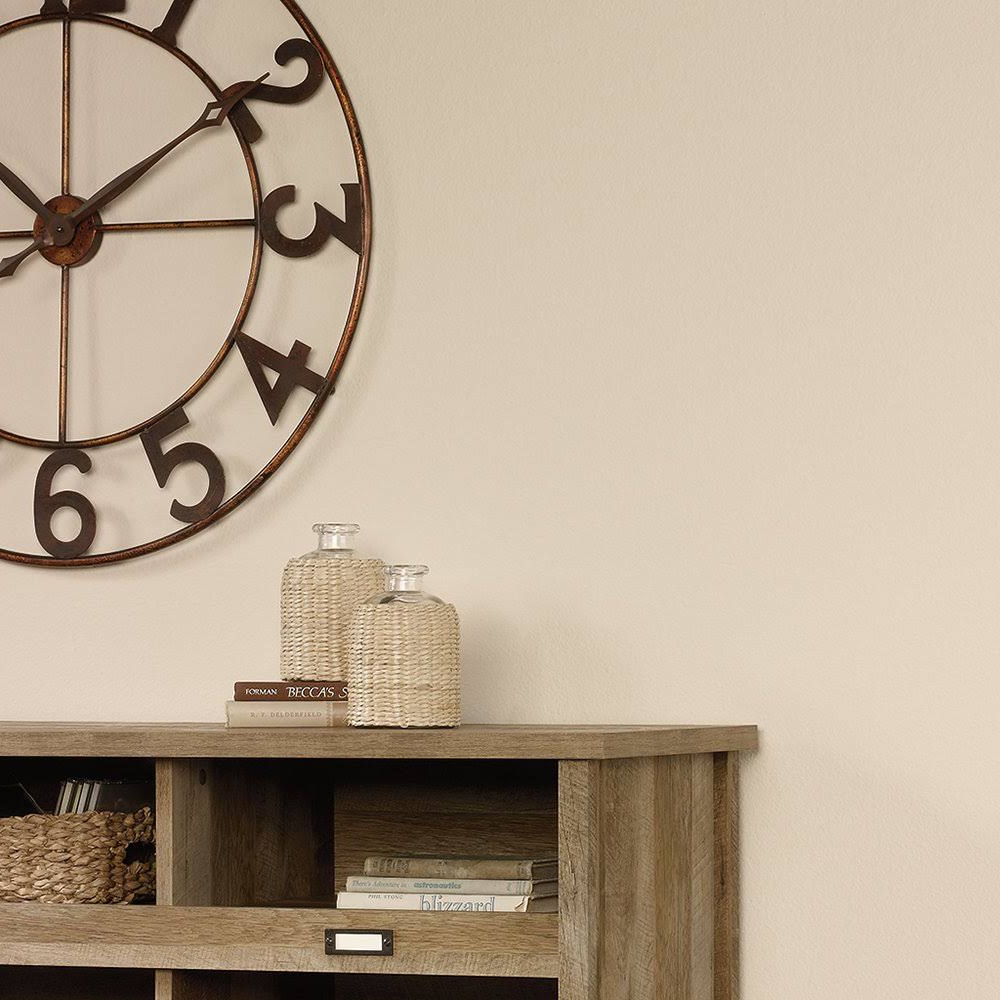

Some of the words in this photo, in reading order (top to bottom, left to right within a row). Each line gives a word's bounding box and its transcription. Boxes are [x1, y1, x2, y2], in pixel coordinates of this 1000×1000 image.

[220, 38, 325, 144] 2
[260, 183, 362, 258] 3
[234, 330, 333, 426] 4
[33, 448, 97, 559] 6
[139, 406, 226, 523] 5
[286, 686, 335, 698] BECCA'S
[414, 881, 462, 890] astronautics
[420, 894, 495, 912] blizzard
